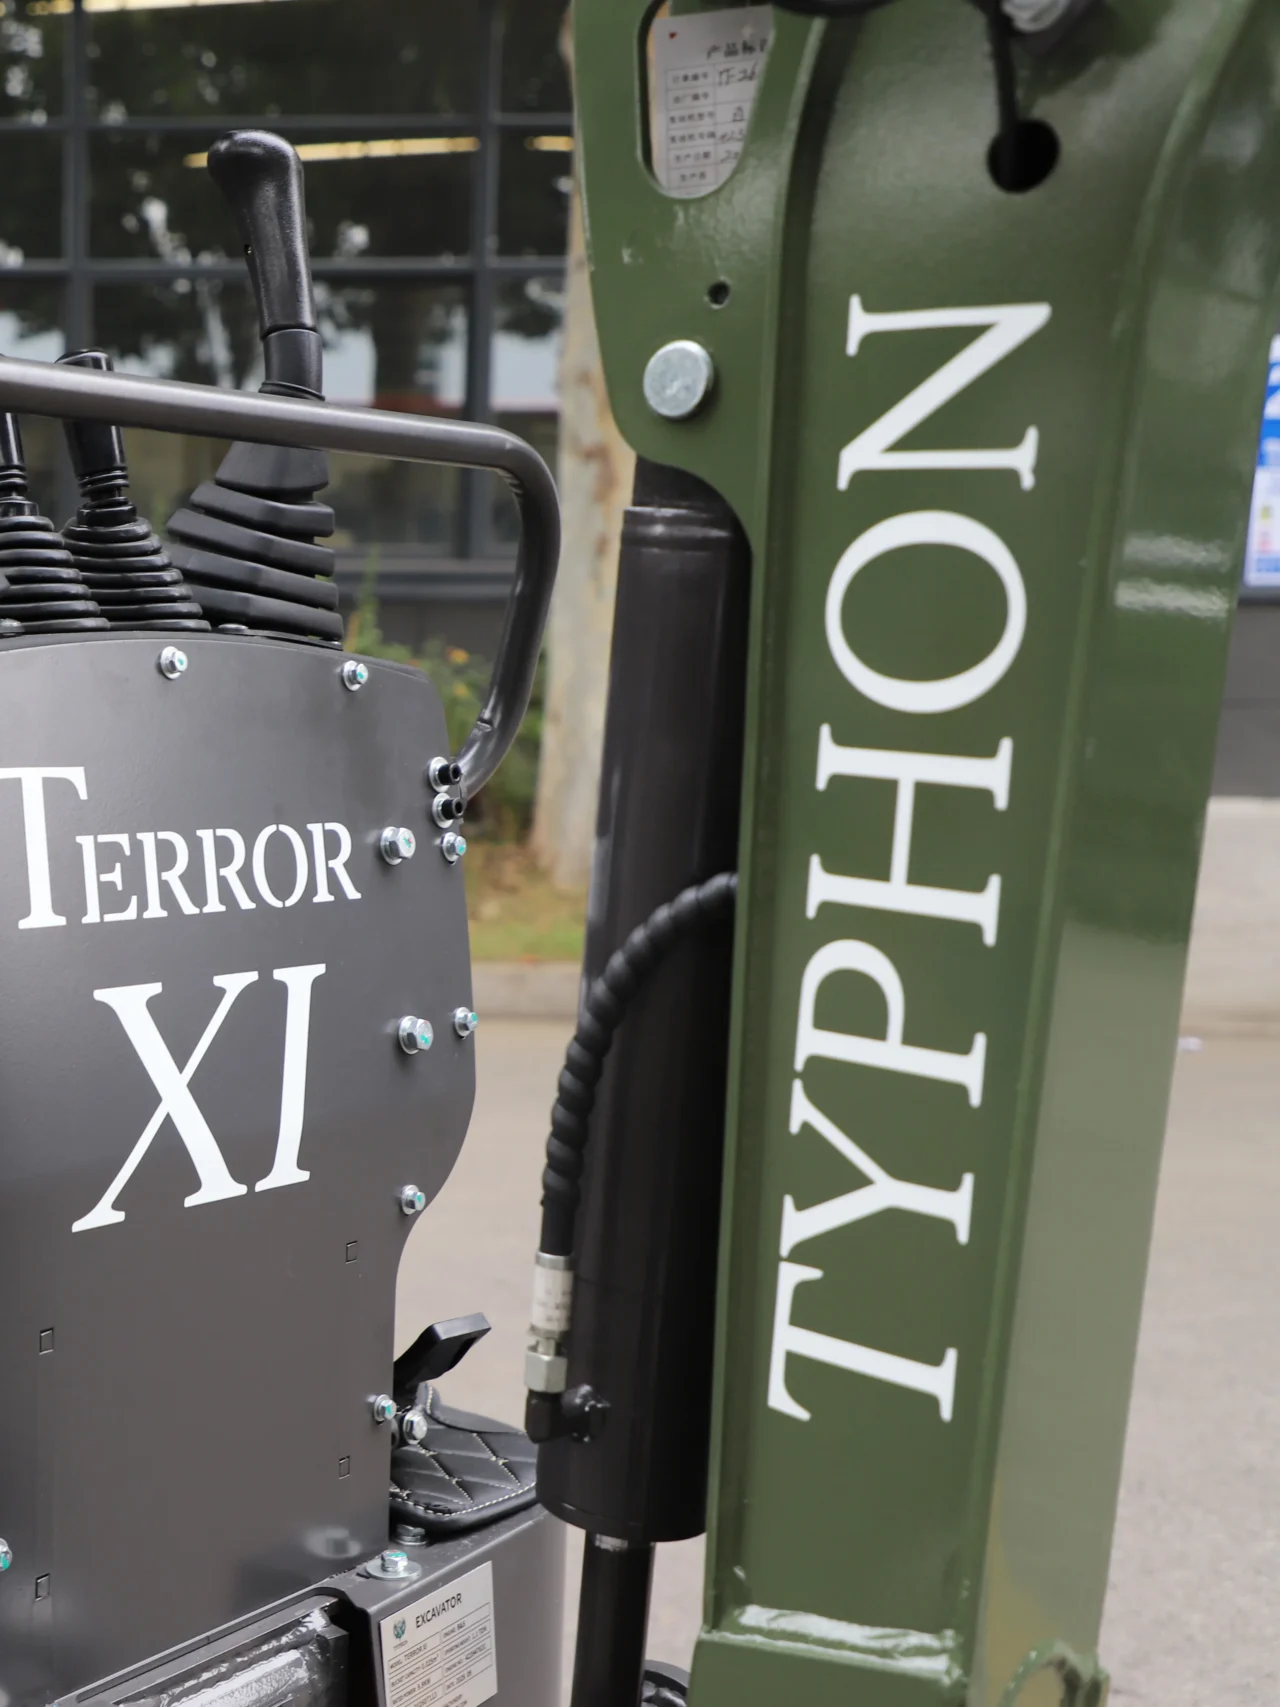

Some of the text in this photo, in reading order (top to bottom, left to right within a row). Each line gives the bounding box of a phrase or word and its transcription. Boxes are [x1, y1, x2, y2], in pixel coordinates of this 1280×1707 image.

[767, 295, 1051, 1423] TYPHON
[71, 962, 327, 1234] XI
[415, 1592, 463, 1629] EXCAVATOR
